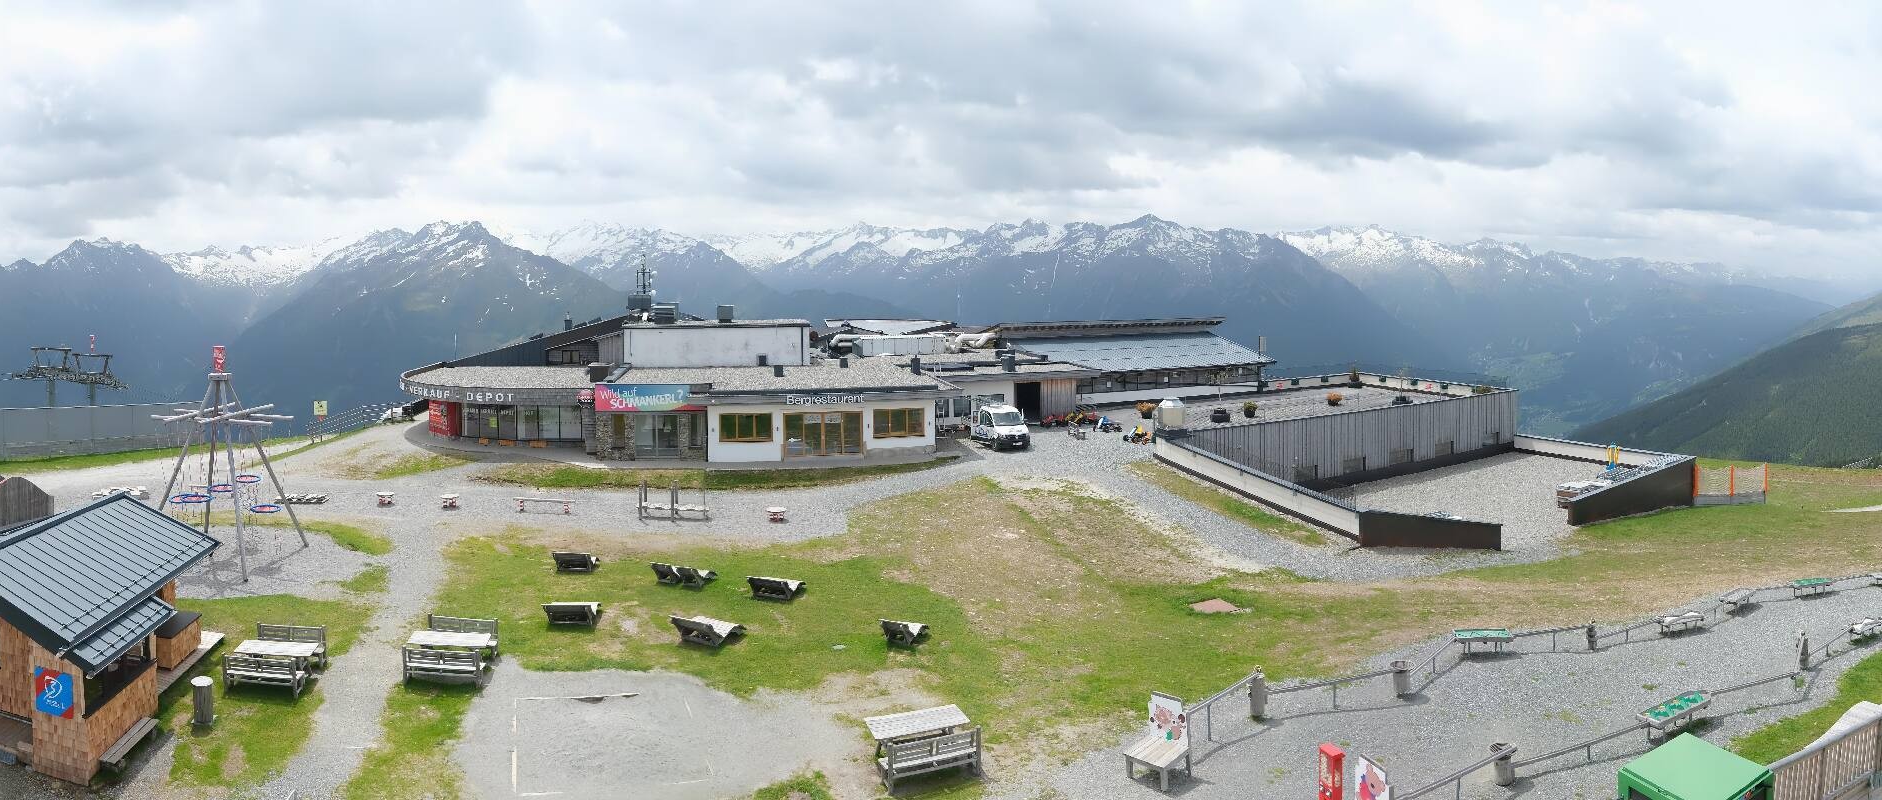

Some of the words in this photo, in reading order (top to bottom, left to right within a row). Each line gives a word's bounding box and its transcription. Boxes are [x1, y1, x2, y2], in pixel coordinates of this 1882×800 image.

[409, 386, 450, 399] VERKAUF
[466, 392, 515, 402] DEPOT
[600, 388, 621, 400] Wild
[622, 387, 637, 398] auf
[786, 394, 864, 406] Bergrestaurant
